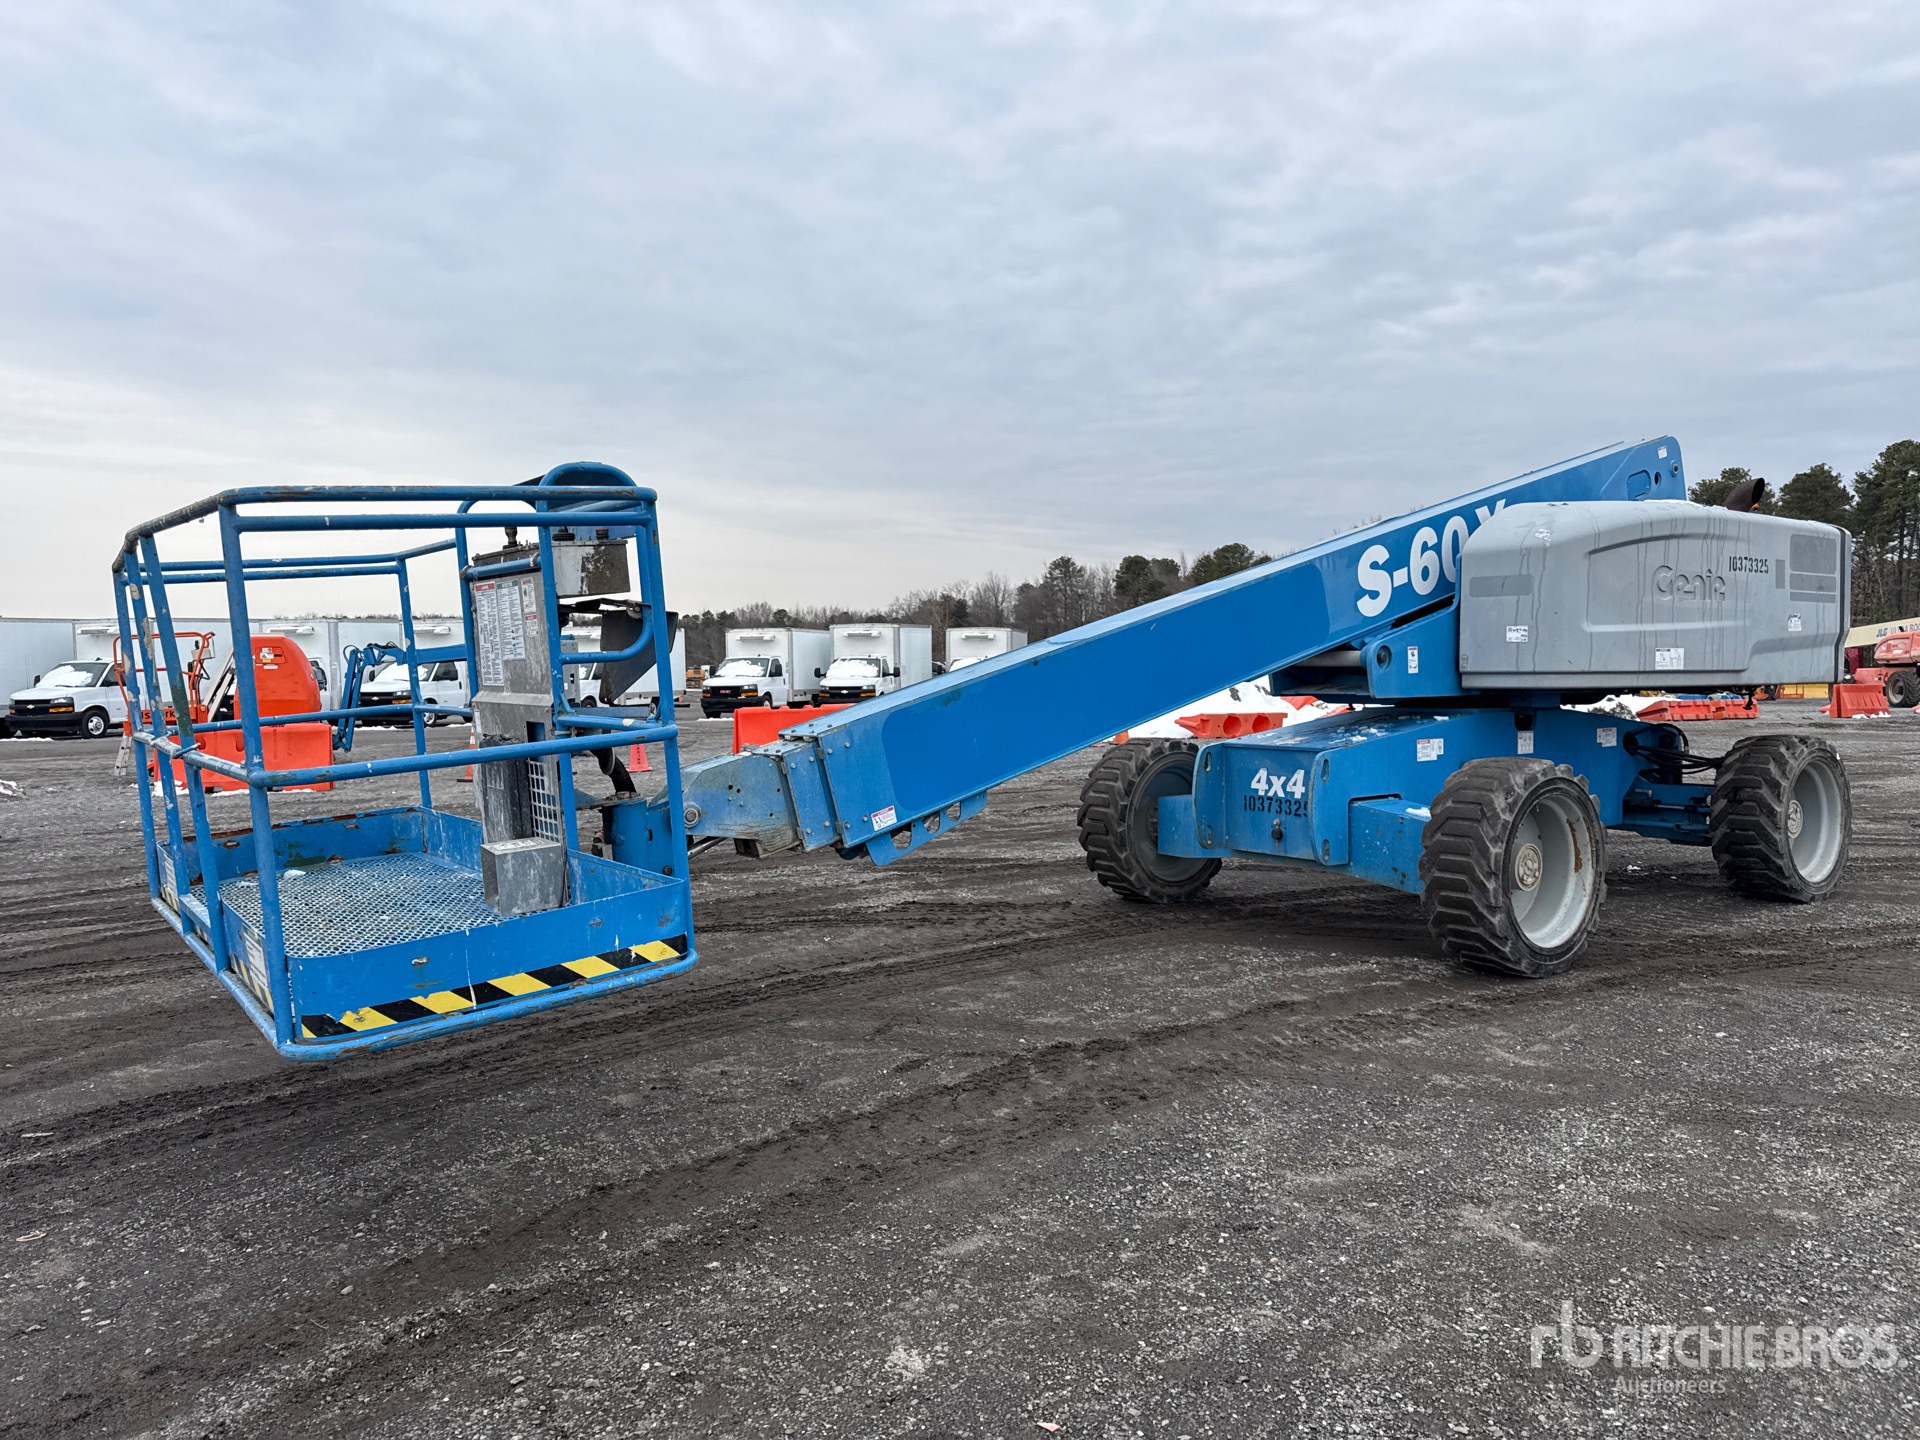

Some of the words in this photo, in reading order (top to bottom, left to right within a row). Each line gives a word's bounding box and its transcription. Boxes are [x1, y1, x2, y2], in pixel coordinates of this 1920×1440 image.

[1728, 556, 1769, 574] 10373325
[1652, 564, 1726, 602] Genie
[1250, 768, 1306, 799] 4x4
